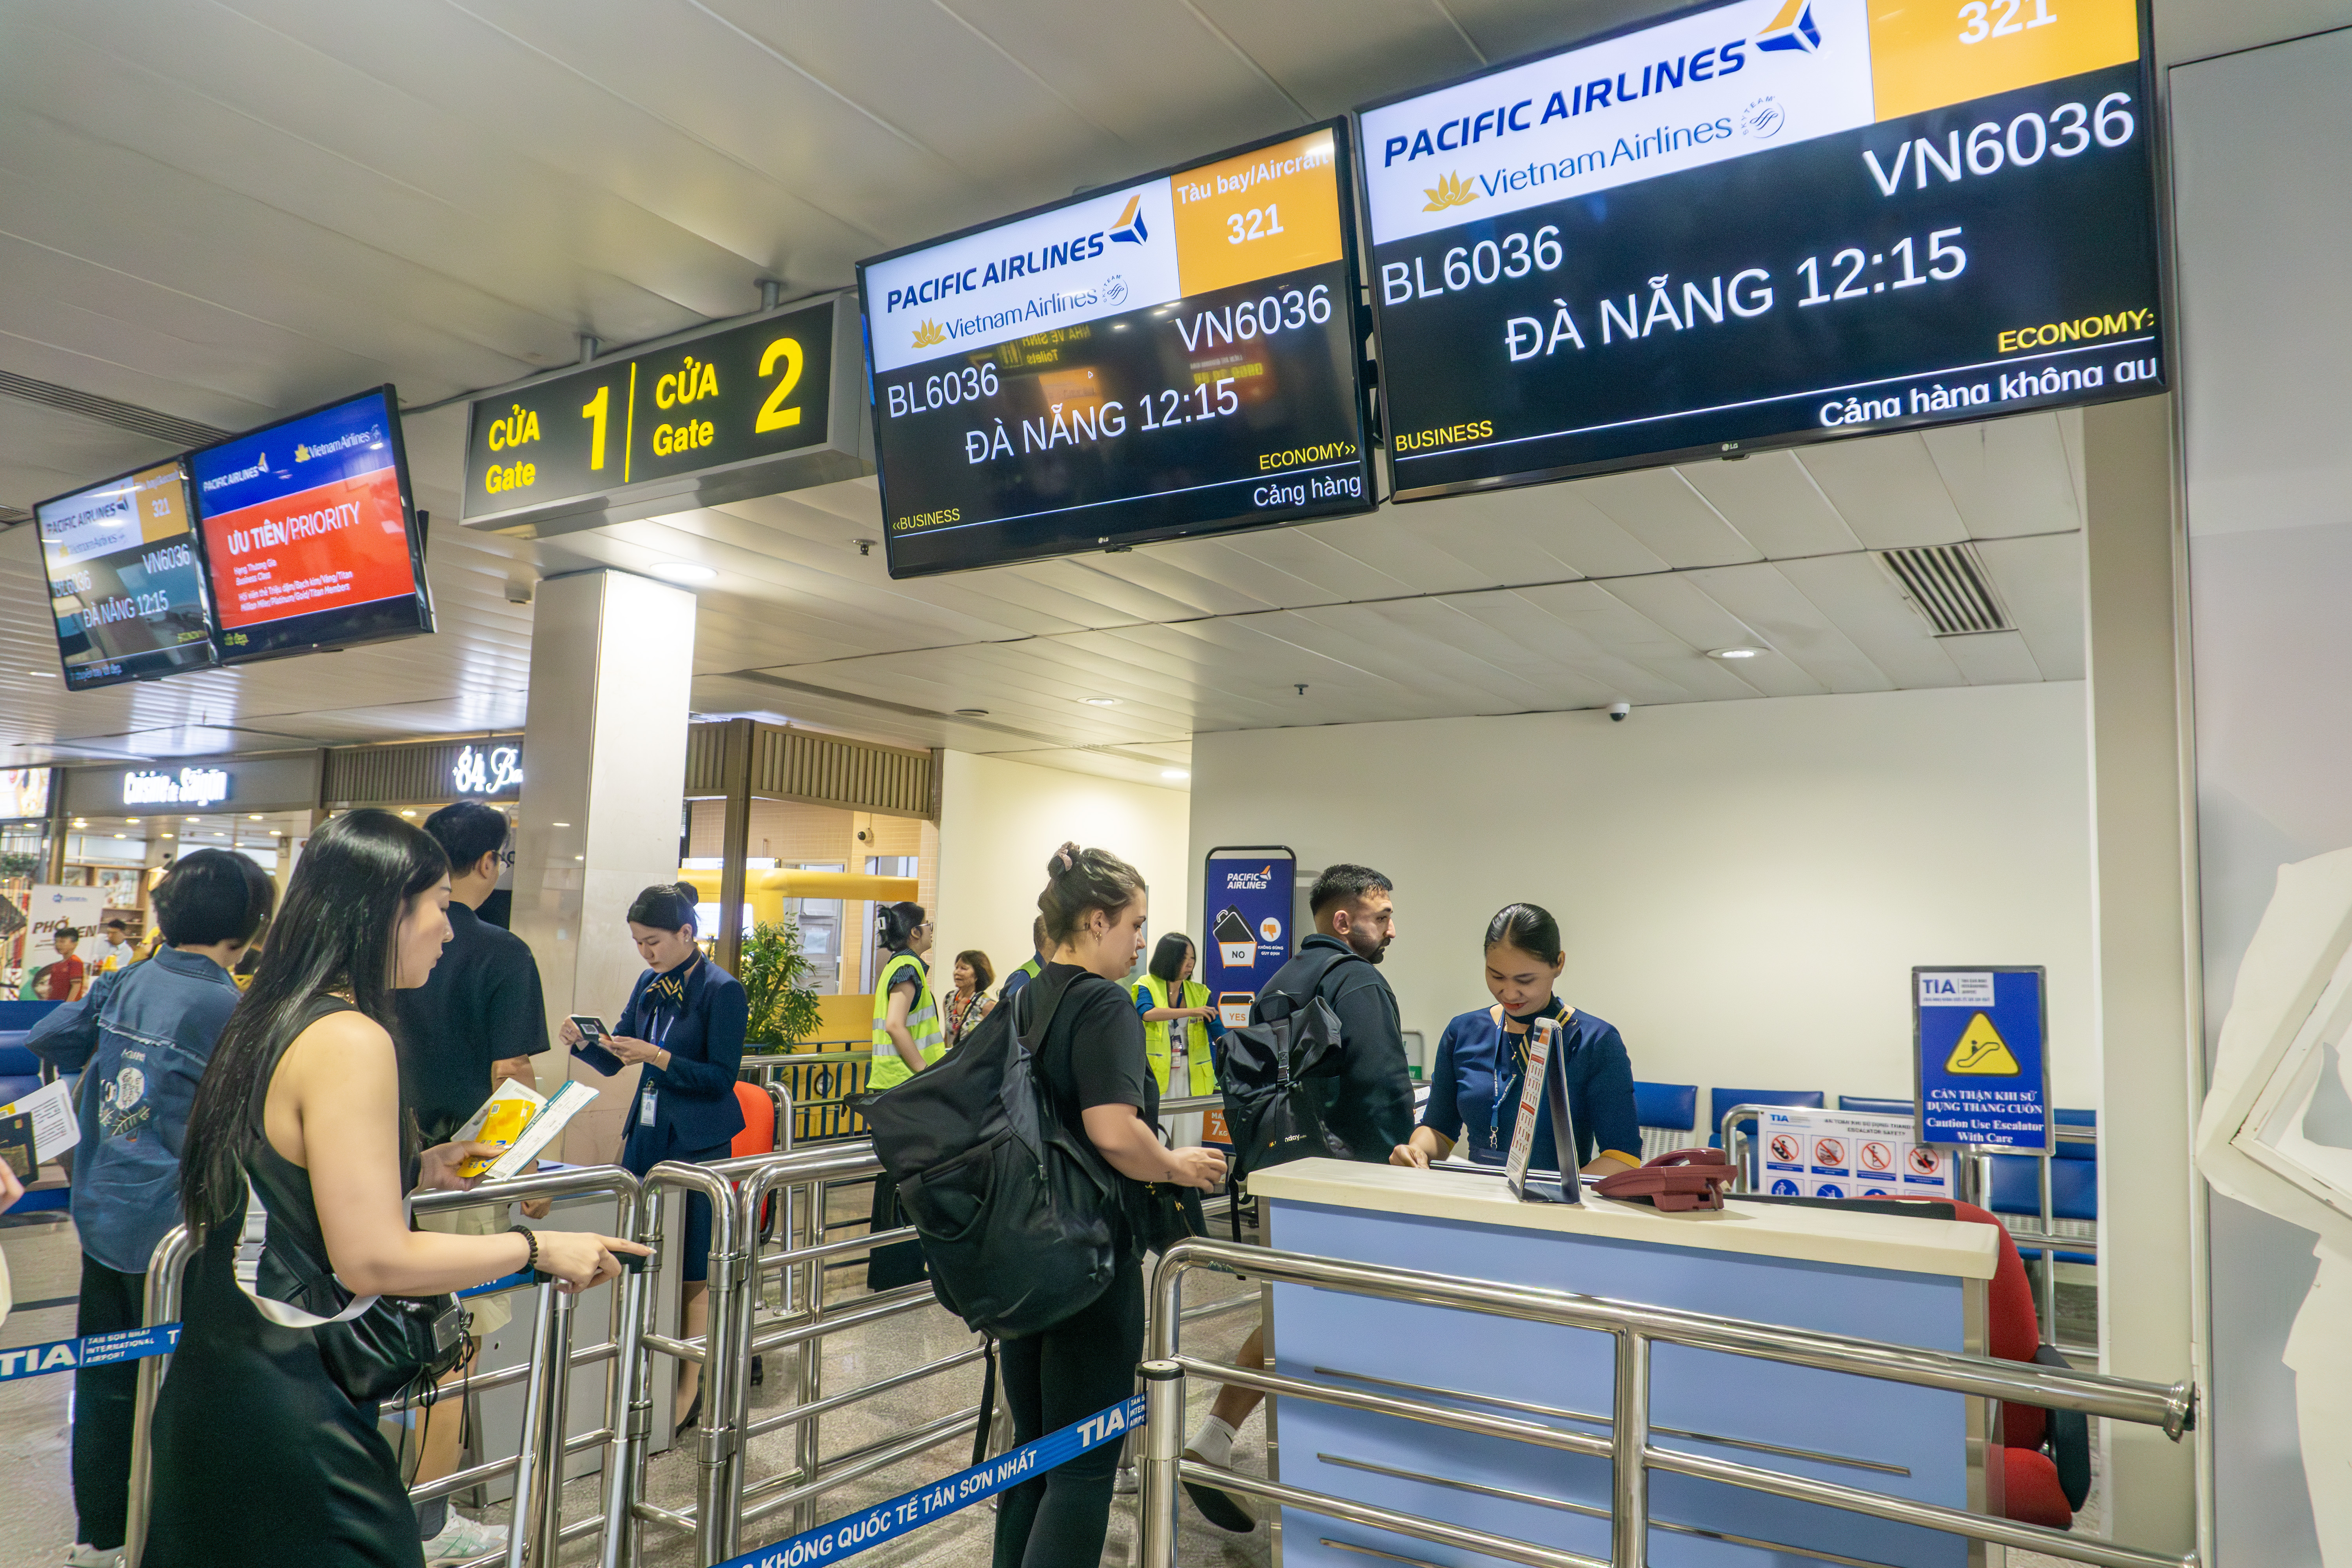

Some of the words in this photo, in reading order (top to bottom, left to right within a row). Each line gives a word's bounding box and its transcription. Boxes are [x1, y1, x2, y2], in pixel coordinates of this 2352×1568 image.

[1958, 0, 2057, 44] 321
[1384, 99, 1532, 168] PACIFIC
[1540, 38, 1747, 125] AIRLINES
[1862, 92, 2134, 197] VN6036
[1177, 183, 1211, 204] Tàu
[1227, 203, 1284, 245] 321
[887, 266, 977, 314] PACIFIC
[981, 231, 1105, 287] AIRLINES
[1382, 225, 1563, 306] BL6036
[1504, 298, 1585, 362] ĐÀ
[1600, 274, 1773, 345] NẴNG
[1797, 227, 1967, 307] 12:15
[1175, 283, 1332, 354] VN6036
[655, 356, 719, 409] CỬA
[755, 337, 803, 434] 2
[887, 361, 1000, 419] BL6036
[488, 404, 540, 451] CỬA
[581, 385, 609, 470] 1
[653, 418, 714, 457] Gate
[964, 417, 1014, 466] ĐÀ
[1022, 398, 1127, 455] NẴNG
[1140, 377, 1239, 432] 12:15
[1395, 420, 1493, 452] BUSINESS
[203, 475, 227, 492] PACIFIC
[227, 466, 259, 485] AIRLINES
[485, 460, 536, 494] Gate
[1253, 481, 1305, 508] Cảng
[1310, 473, 1362, 501] hàng
[152, 497, 171, 518] 321
[142, 543, 191, 574] VN6036
[82, 601, 101, 628] ĐÀ
[101, 596, 136, 626] NẴNG
[136, 589, 169, 616] 12:15
[1227, 873, 1259, 881] PACIFIC
[77, 925, 97, 937] EN
[1922, 979, 1956, 993] TIA
[1229, 1013, 1246, 1021] YES
[1927, 1101, 1960, 1113] DỤNG
[1962, 1102, 2006, 1113] THANG
[1994, 1091, 2018, 1101] KHI
[1770, 1114, 1789, 1122] TIA
[1926, 1118, 1968, 1129] Caution
[1971, 1119, 1991, 1129] Use
[1993, 1120, 2044, 1131] Escalator
[1958, 1131, 1984, 1142] With
[1985, 1132, 2013, 1144] Care
[86, 1338, 154, 1354] INTERNATIONAL
[107, 1333, 126, 1342] SON
[0, 1344, 76, 1375] TIA
[86, 1350, 125, 1363] AIRPORT
[1131, 1396, 1140, 1406] TAN
[1077, 1407, 1125, 1447] TIA
[838, 1510, 891, 1548] QUỐC
[896, 1494, 918, 1524] TẾ
[922, 1487, 955, 1514] TÂN
[959, 1469, 993, 1498] SƠN
[997, 1448, 1037, 1483] NHẤT
